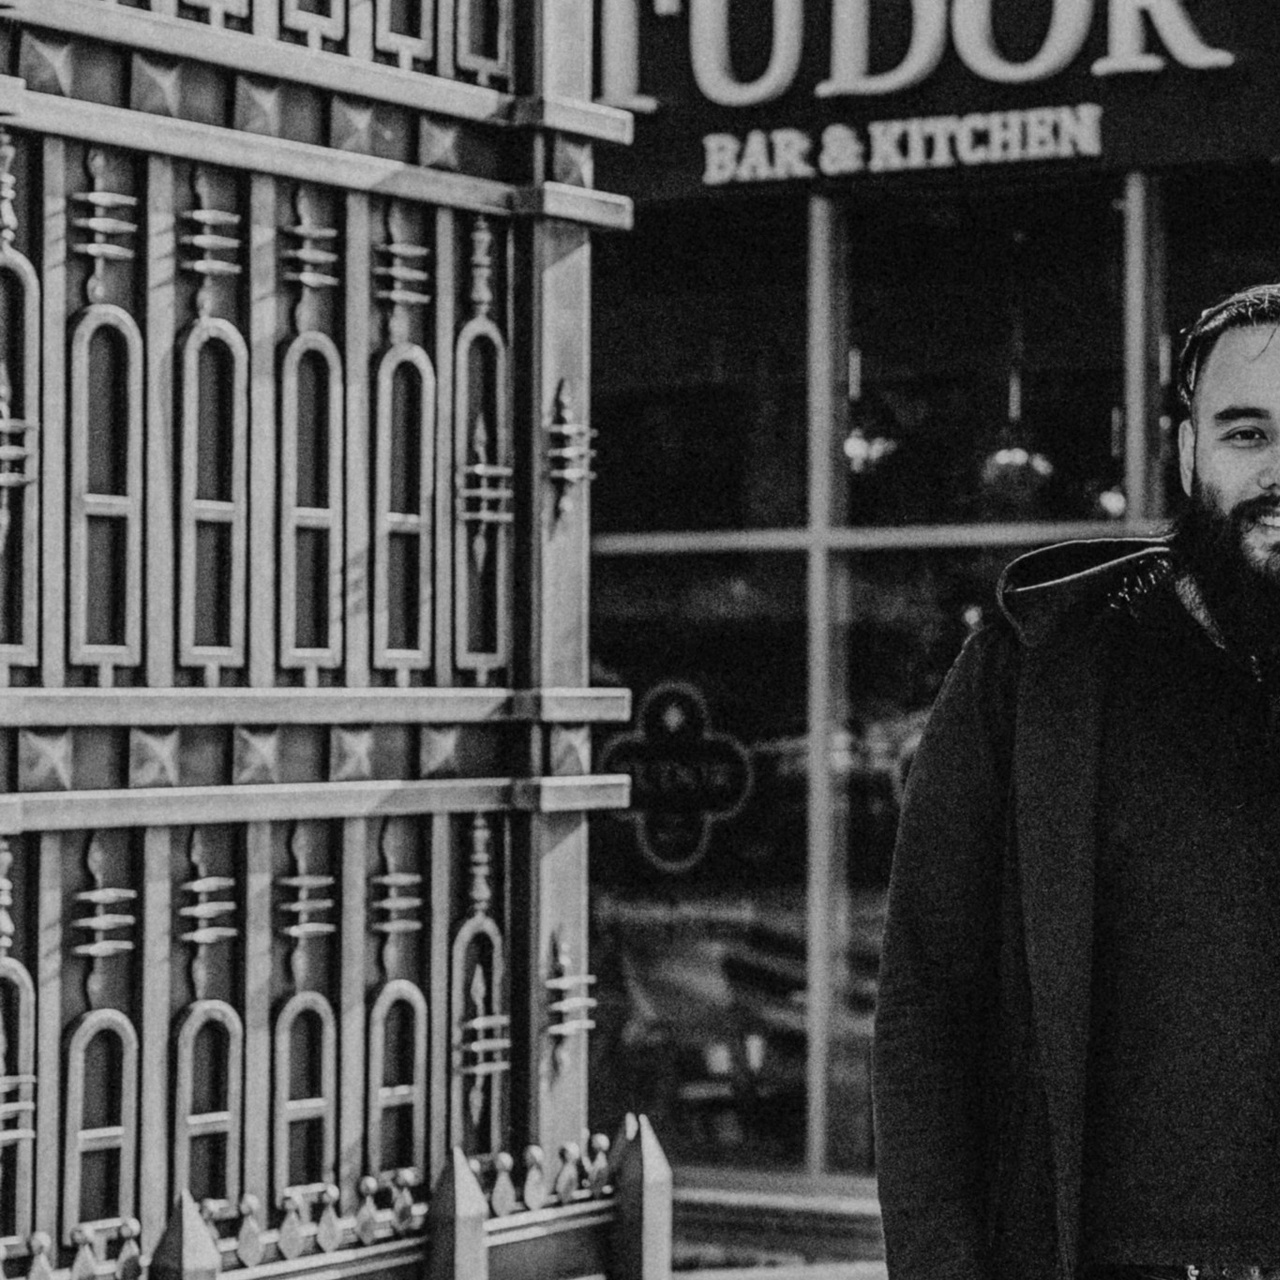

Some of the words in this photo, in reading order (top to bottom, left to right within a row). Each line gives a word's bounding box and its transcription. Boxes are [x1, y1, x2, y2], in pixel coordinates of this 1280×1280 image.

[702, 128, 816, 185] BAR
[819, 123, 863, 175] &
[867, 102, 1102, 172] KITCHEN
